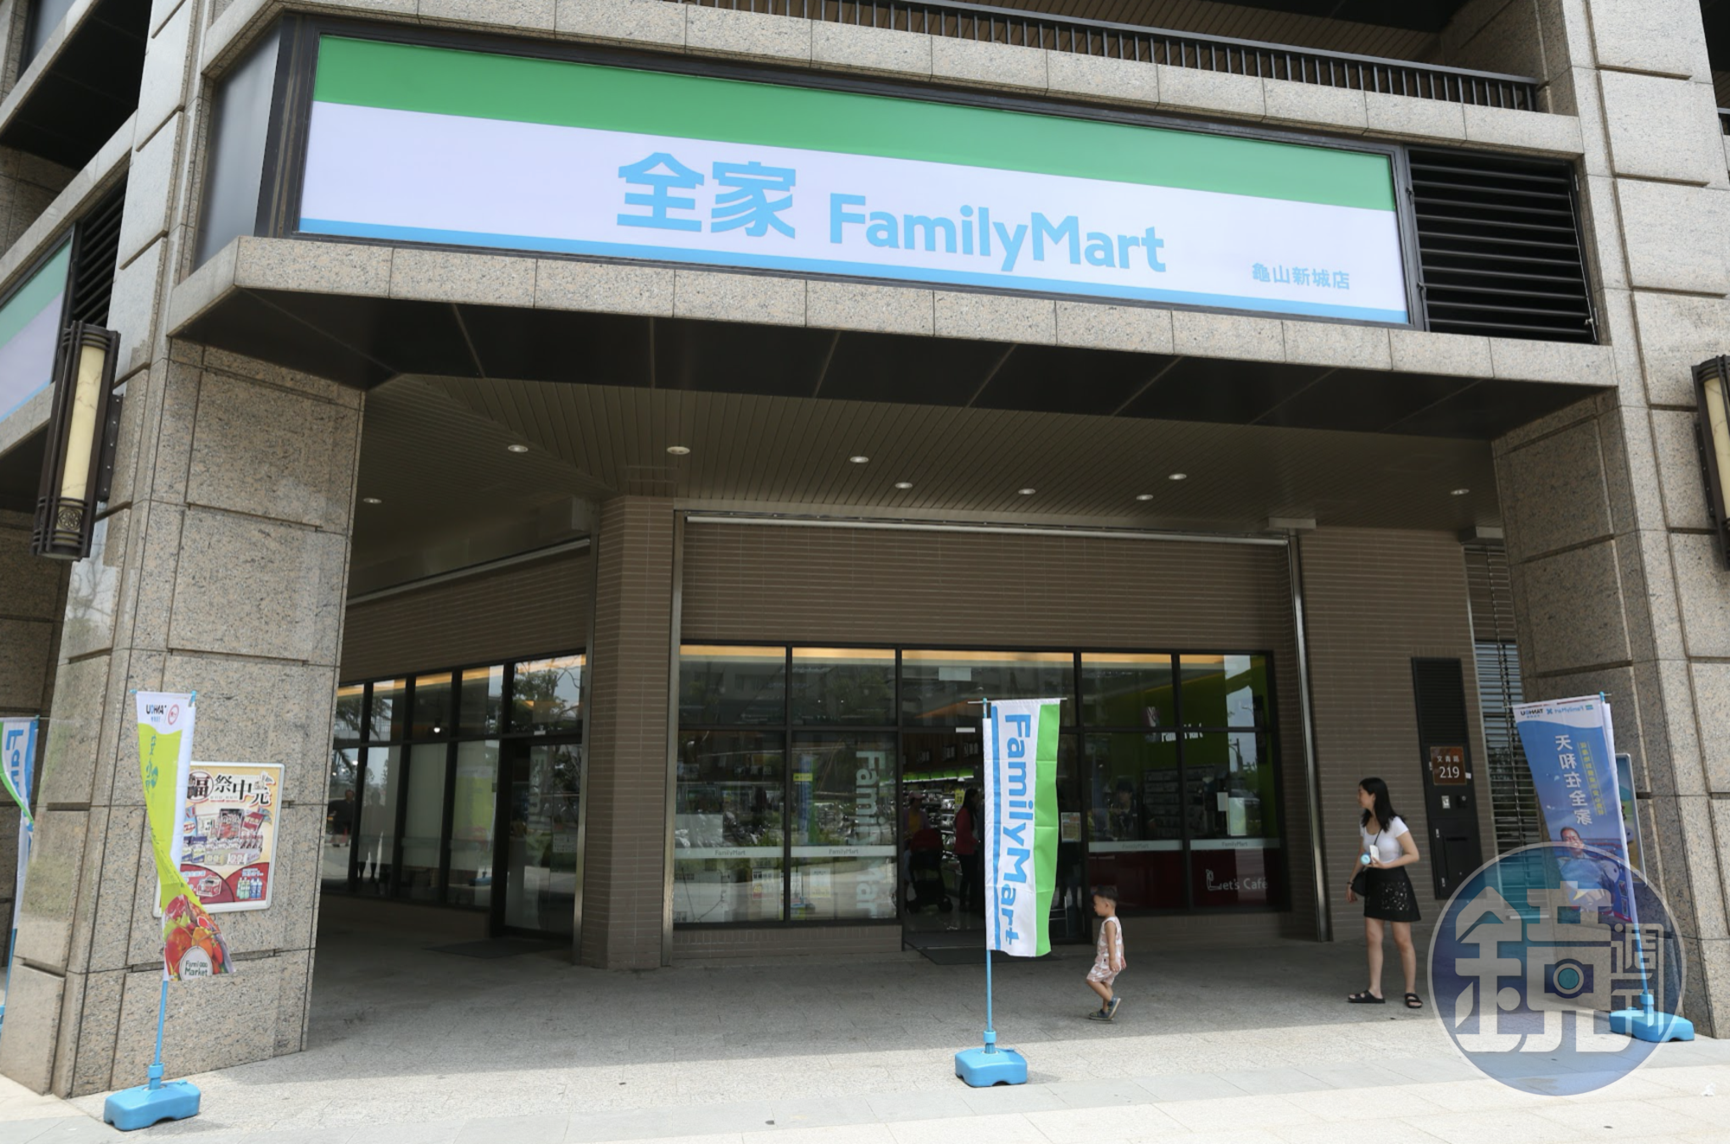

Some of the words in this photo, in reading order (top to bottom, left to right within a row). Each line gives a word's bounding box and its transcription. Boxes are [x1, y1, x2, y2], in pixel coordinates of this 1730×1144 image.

[617, 152, 796, 239] 全家
[830, 193, 1166, 272] FamilyMart
[1252, 262, 1350, 290] 龜山新城店
[1439, 766, 1460, 779] 219
[1000, 714, 1033, 945] FamilyMart
[715, 849, 746, 857] FamilyMart
[828, 848, 859, 856] FamilyMart
[1243, 877, 1268, 890] Café
[184, 966, 208, 977] Market
